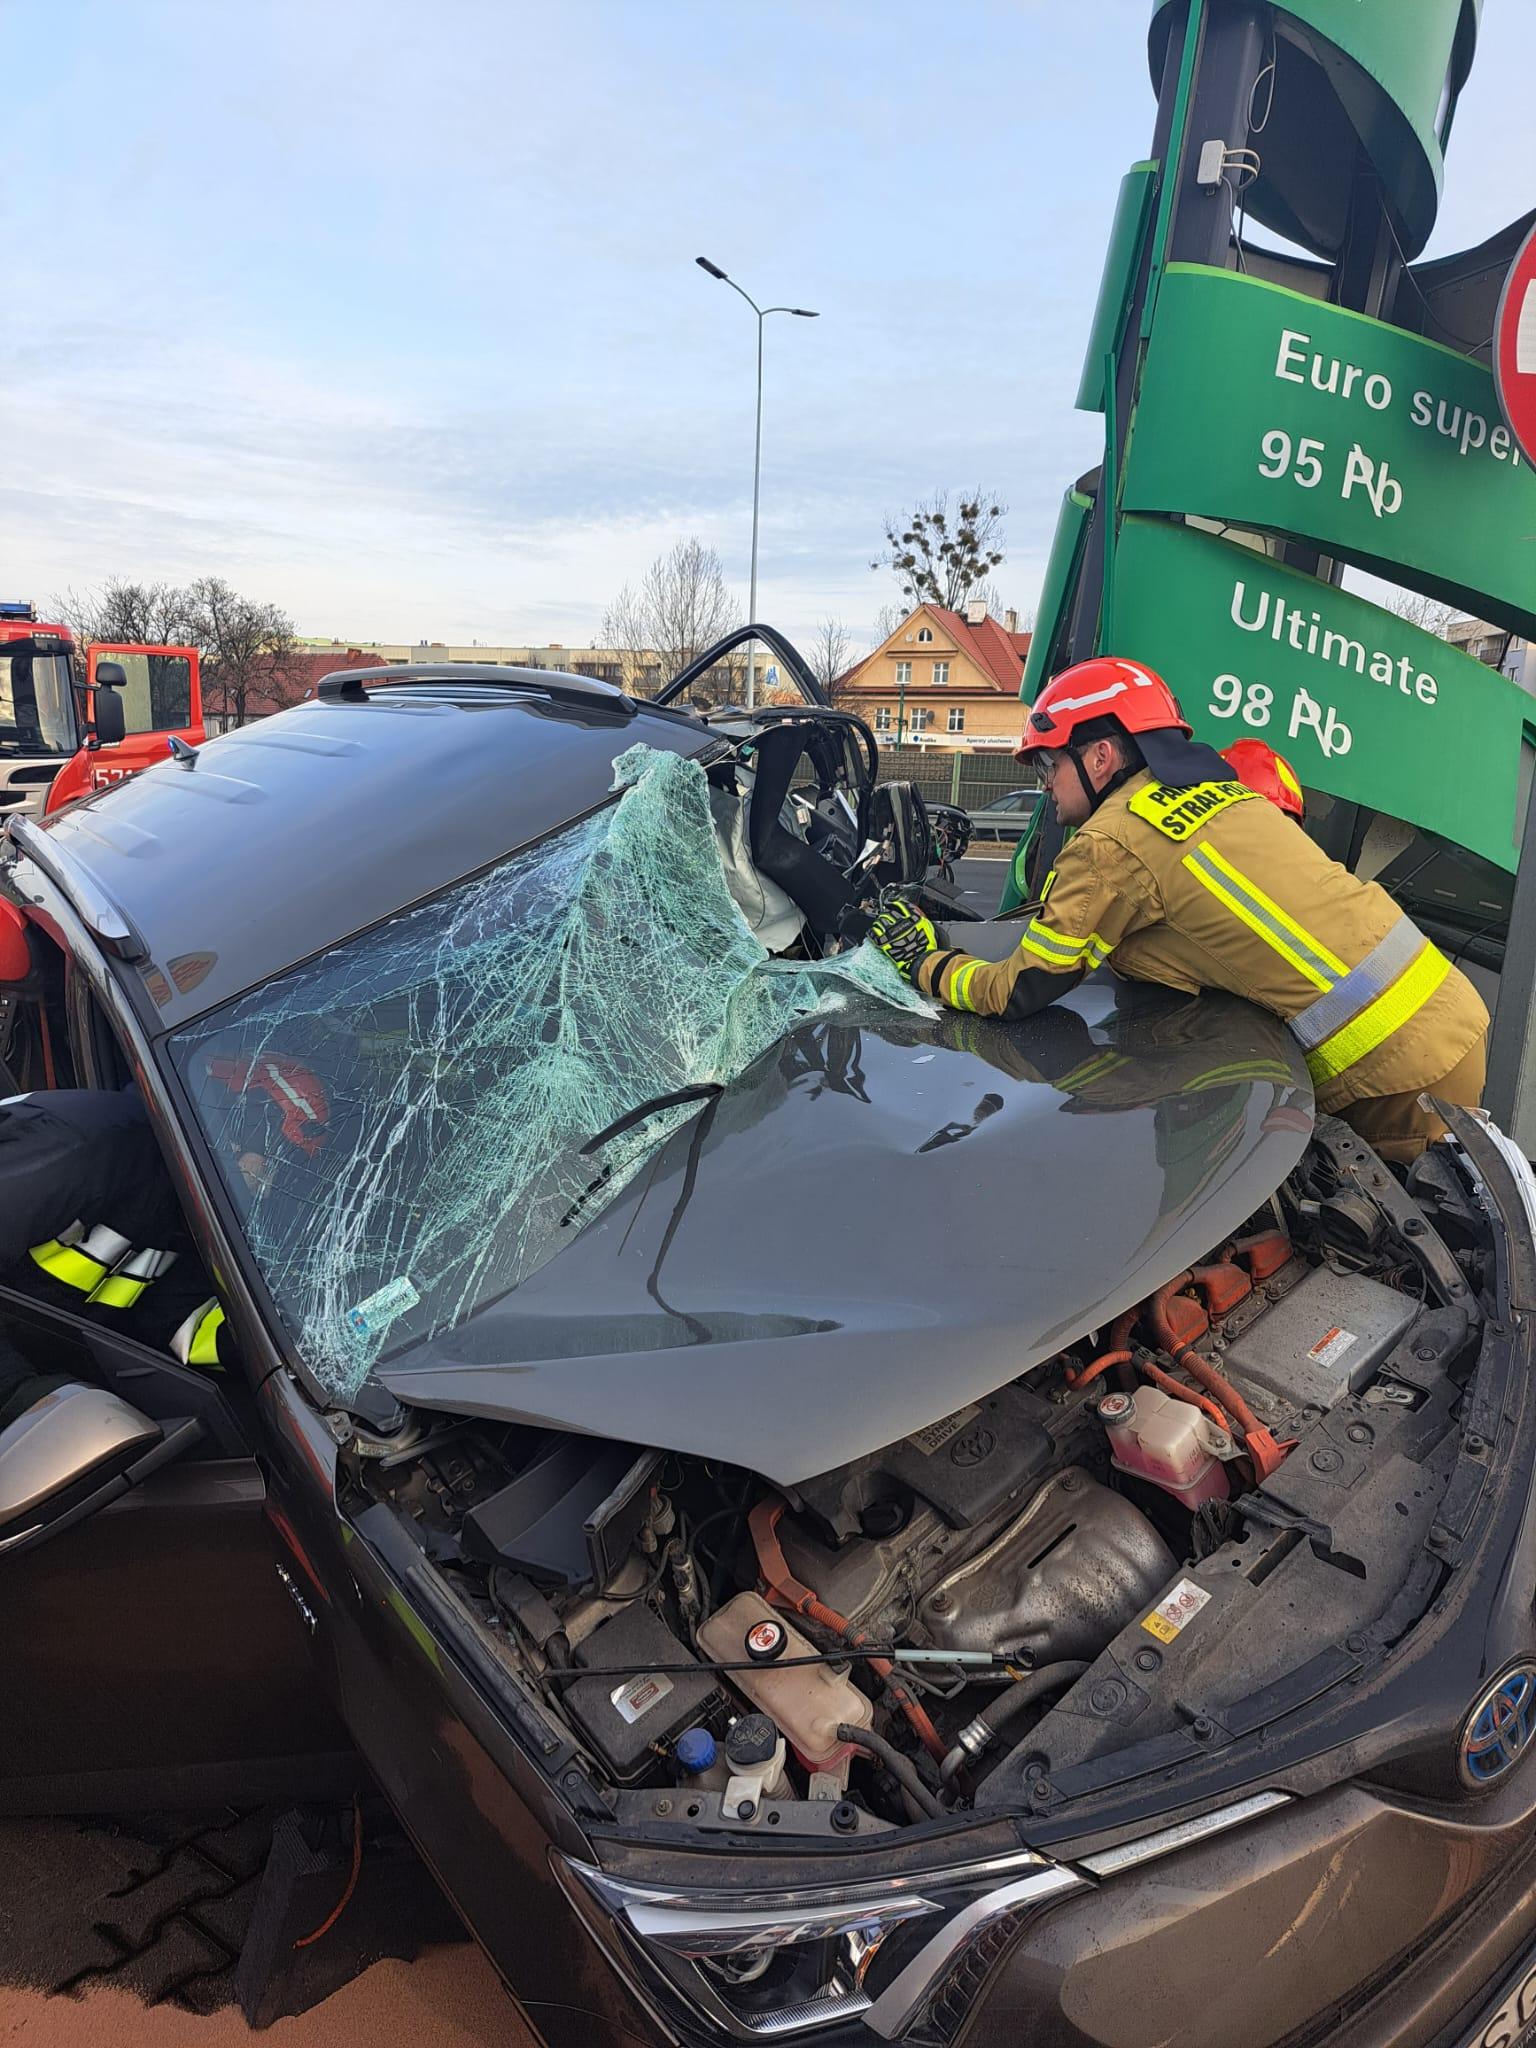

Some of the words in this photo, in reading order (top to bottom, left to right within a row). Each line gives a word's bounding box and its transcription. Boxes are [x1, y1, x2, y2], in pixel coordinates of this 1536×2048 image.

[1275, 328, 1392, 410] Euro
[1258, 429, 1325, 488] 95
[1231, 581, 1438, 705] Ultimate
[1208, 673, 1274, 727] 98
